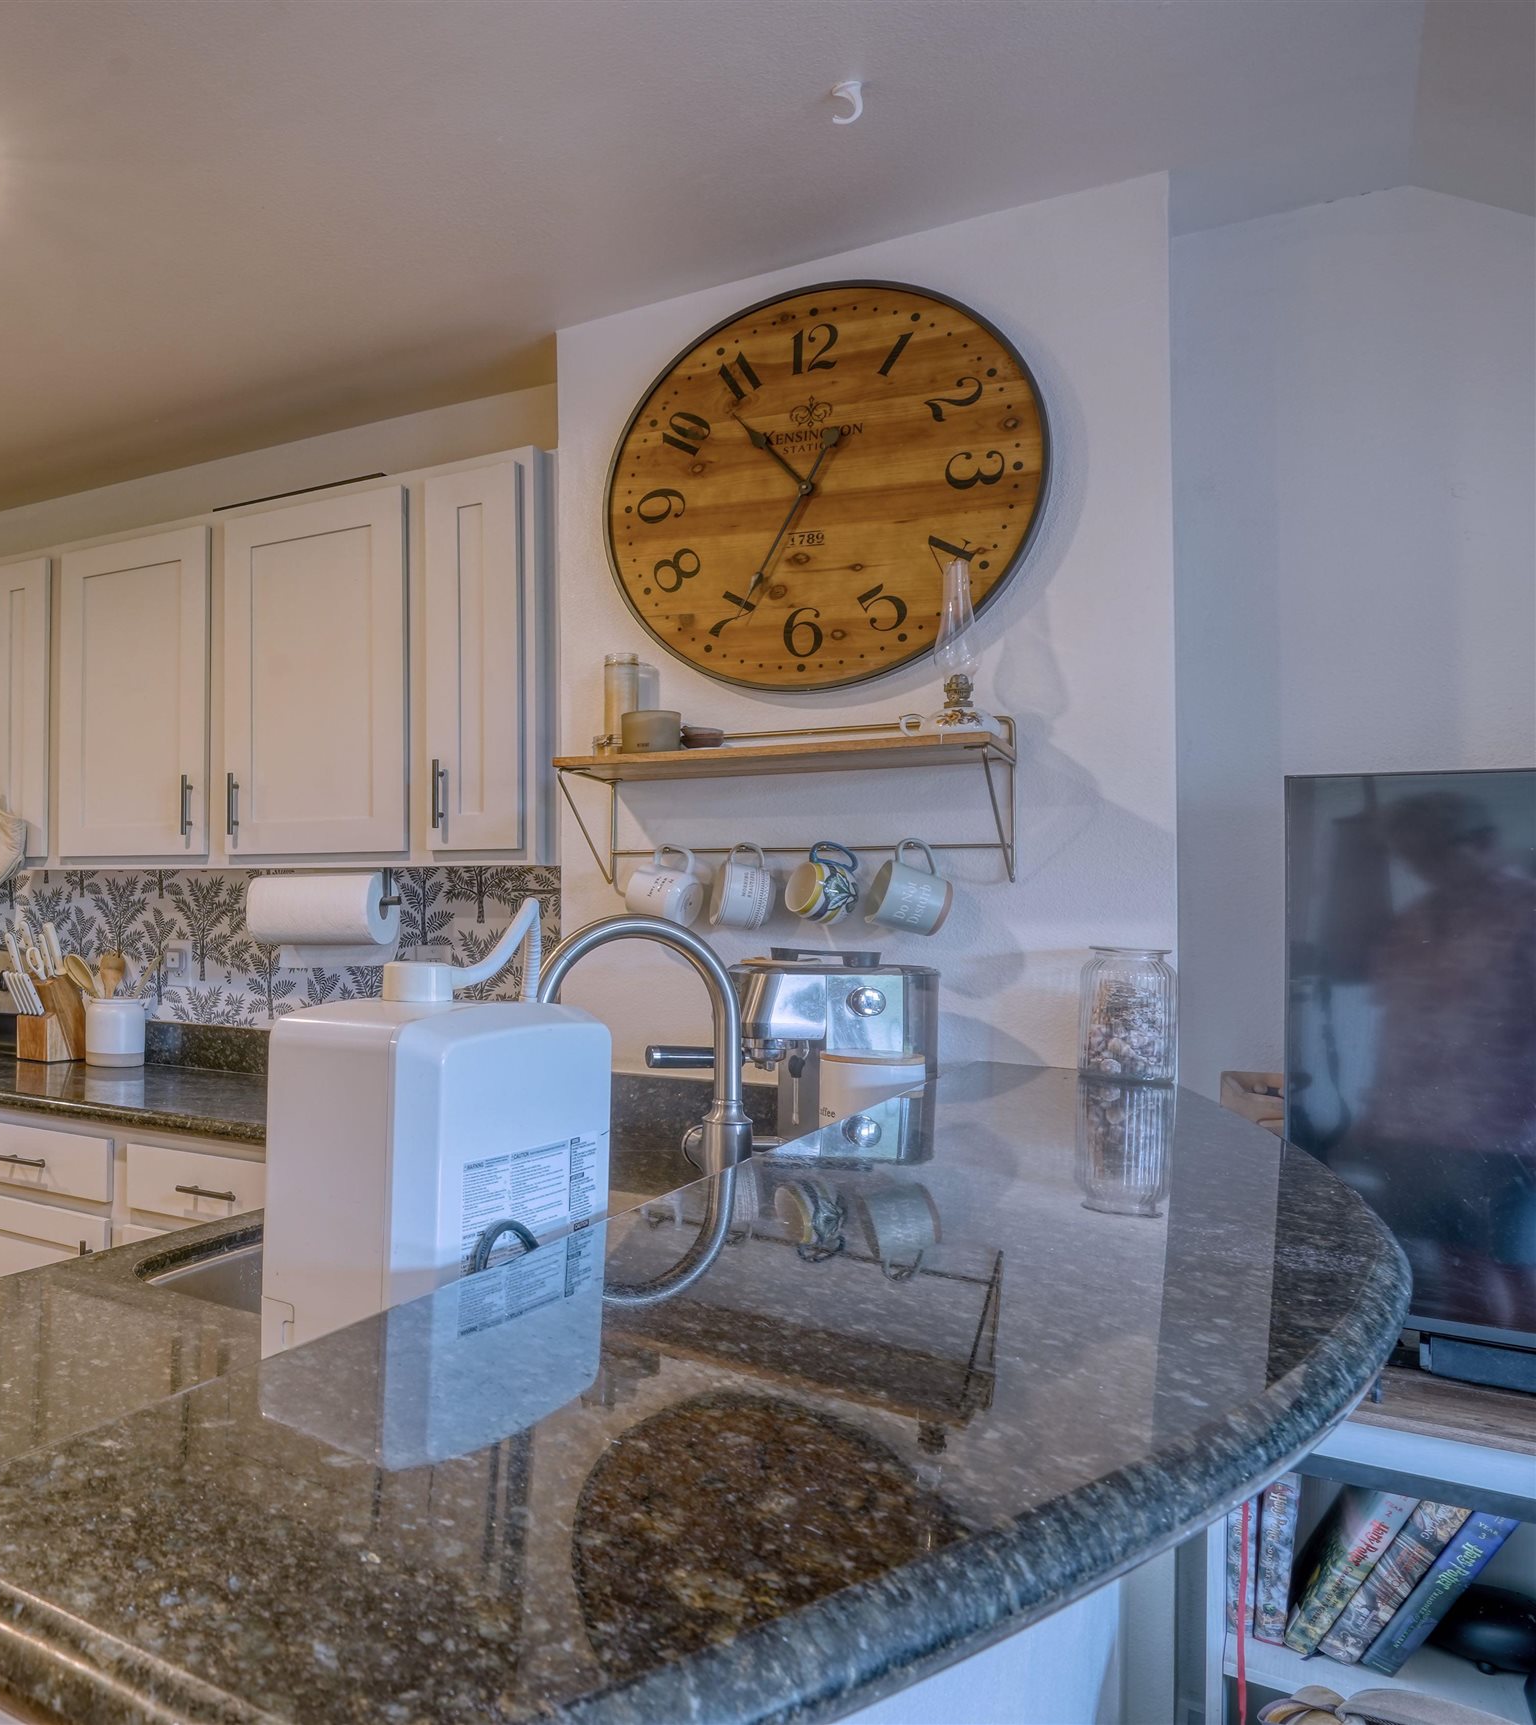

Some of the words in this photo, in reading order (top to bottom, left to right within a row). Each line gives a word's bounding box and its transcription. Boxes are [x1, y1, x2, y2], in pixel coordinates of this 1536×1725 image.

[790, 323, 839, 376] 12
[877, 331, 915, 377] 1
[717, 351, 763, 402] 11
[923, 376, 983, 422] 2
[662, 411, 712, 457] 10
[763, 422, 863, 447] KENSINON
[783, 442, 830, 455] STATI
[945, 450, 1005, 490] 3
[636, 488, 686, 525] 9
[790, 532, 824, 546] 1789
[928, 535, 975, 575] 4
[653, 548, 702, 594] 8
[708, 590, 757, 638] 7
[856, 583, 909, 632] 5
[782, 607, 824, 657] 6
[1435, 1561, 1469, 1590] Potter
